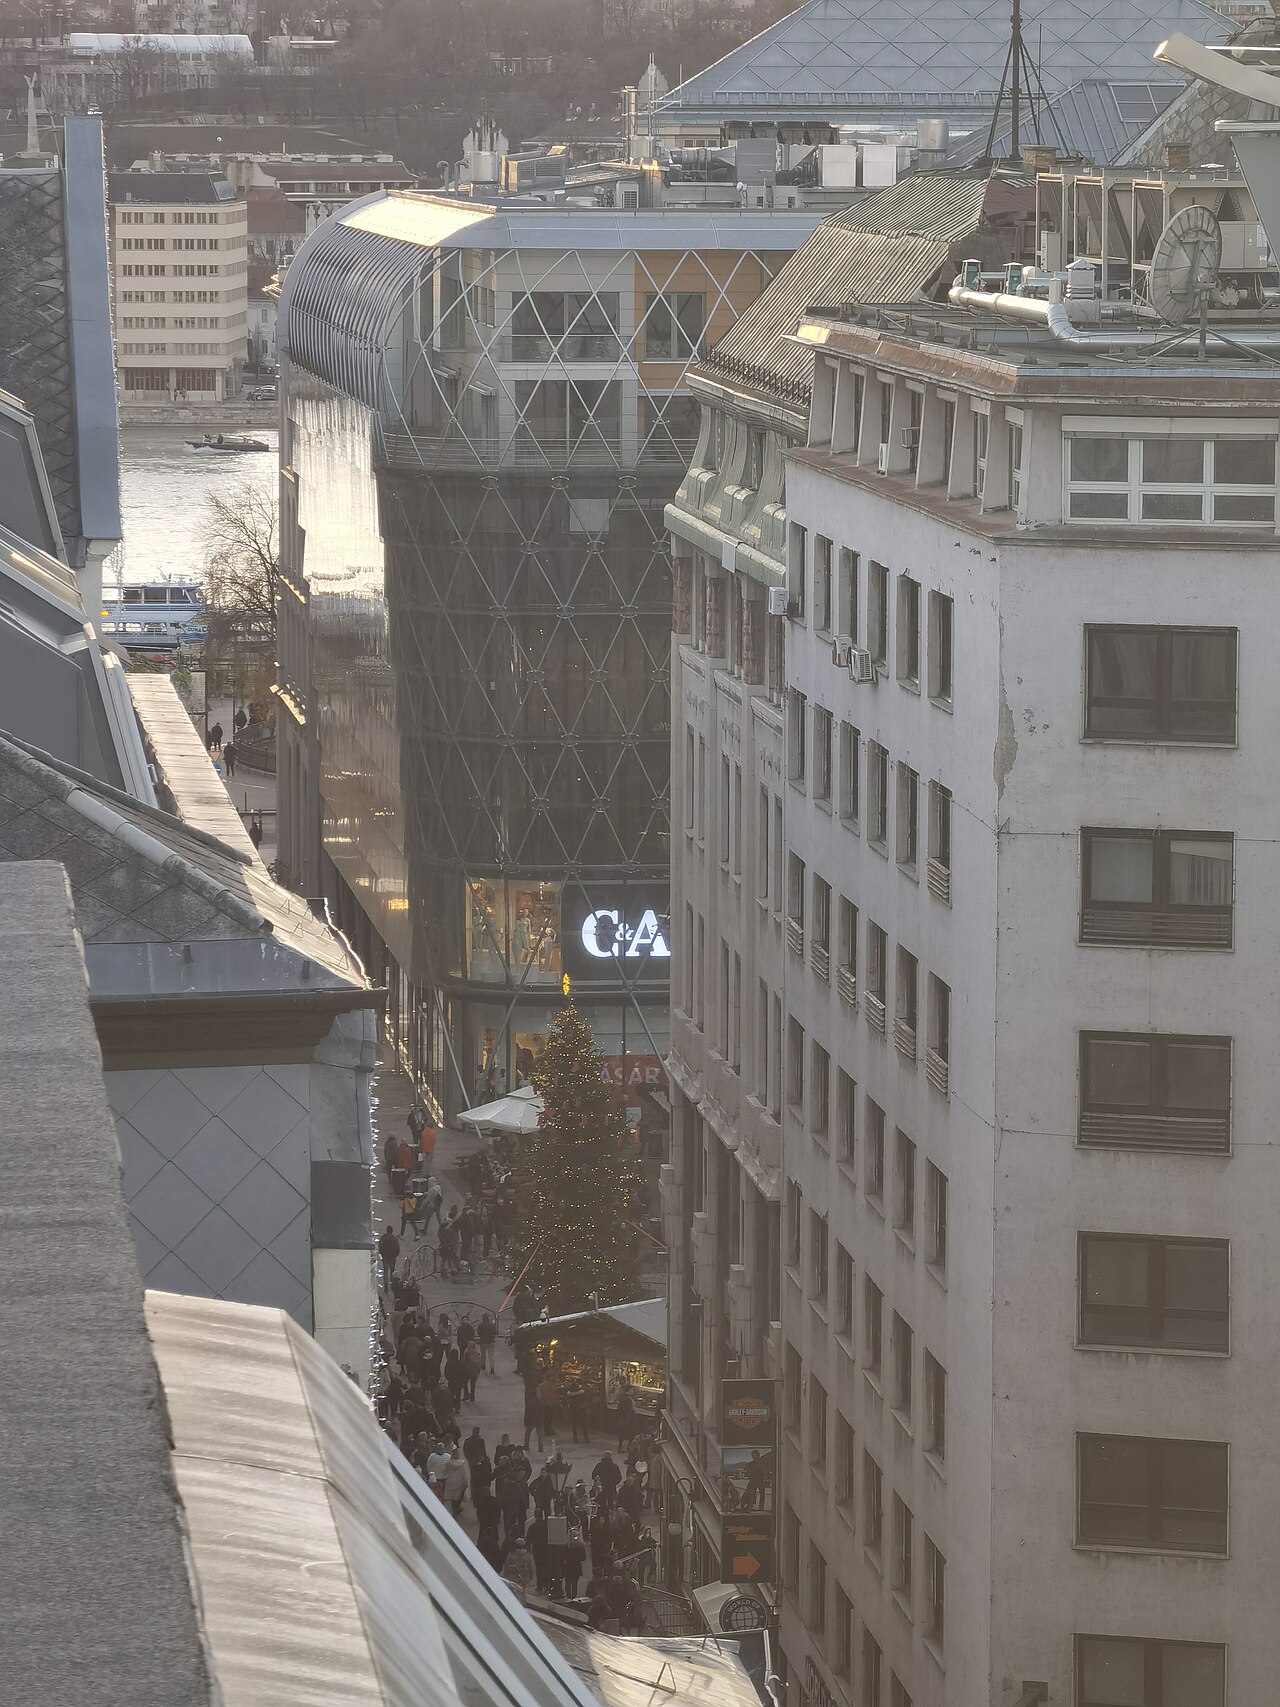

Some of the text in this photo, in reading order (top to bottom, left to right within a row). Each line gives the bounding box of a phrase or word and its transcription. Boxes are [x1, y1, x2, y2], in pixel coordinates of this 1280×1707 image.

[581, 909, 671, 957] C&A
[600, 1061, 661, 1086] ÁSÁR
[727, 1599, 751, 1612] WORLD
